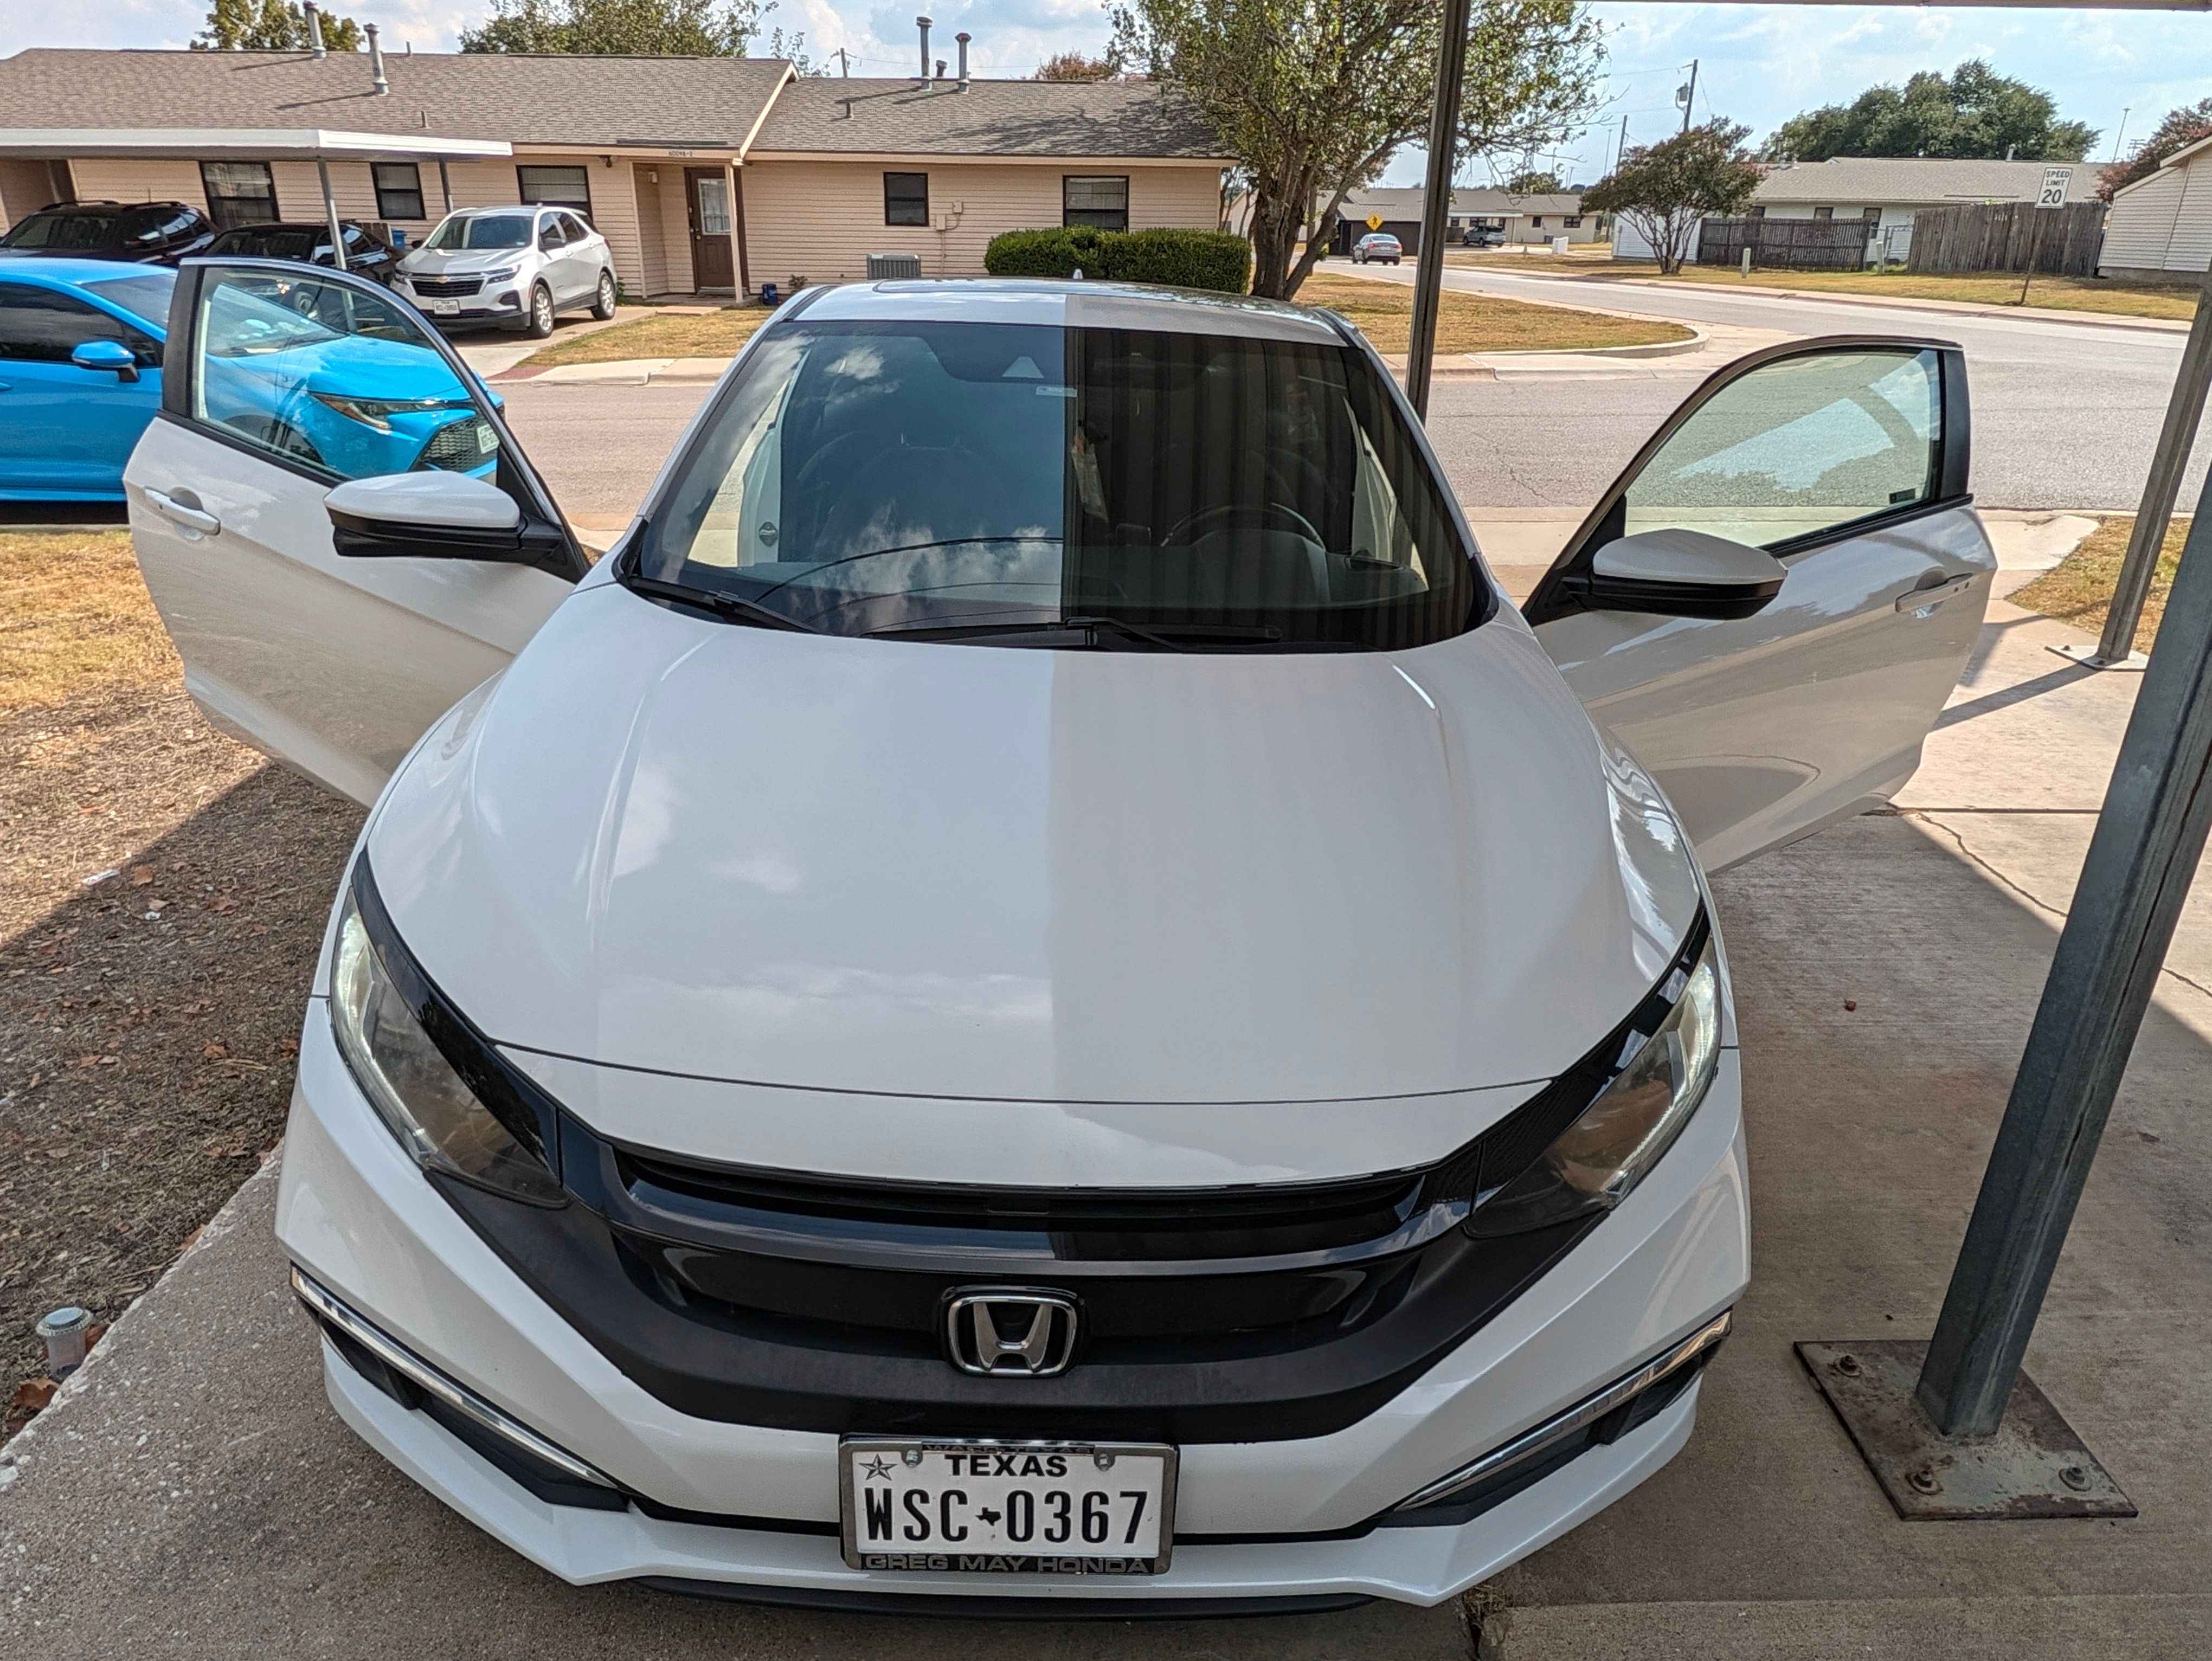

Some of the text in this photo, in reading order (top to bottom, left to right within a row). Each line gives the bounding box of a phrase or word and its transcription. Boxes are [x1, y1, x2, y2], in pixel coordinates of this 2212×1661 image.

[2041, 189, 2062, 204] 20
[944, 1454, 1068, 1477] TEXAS
[1007, 1490, 1148, 1544] 0367
[866, 1555, 1148, 1573] GREG MAY HONDA
